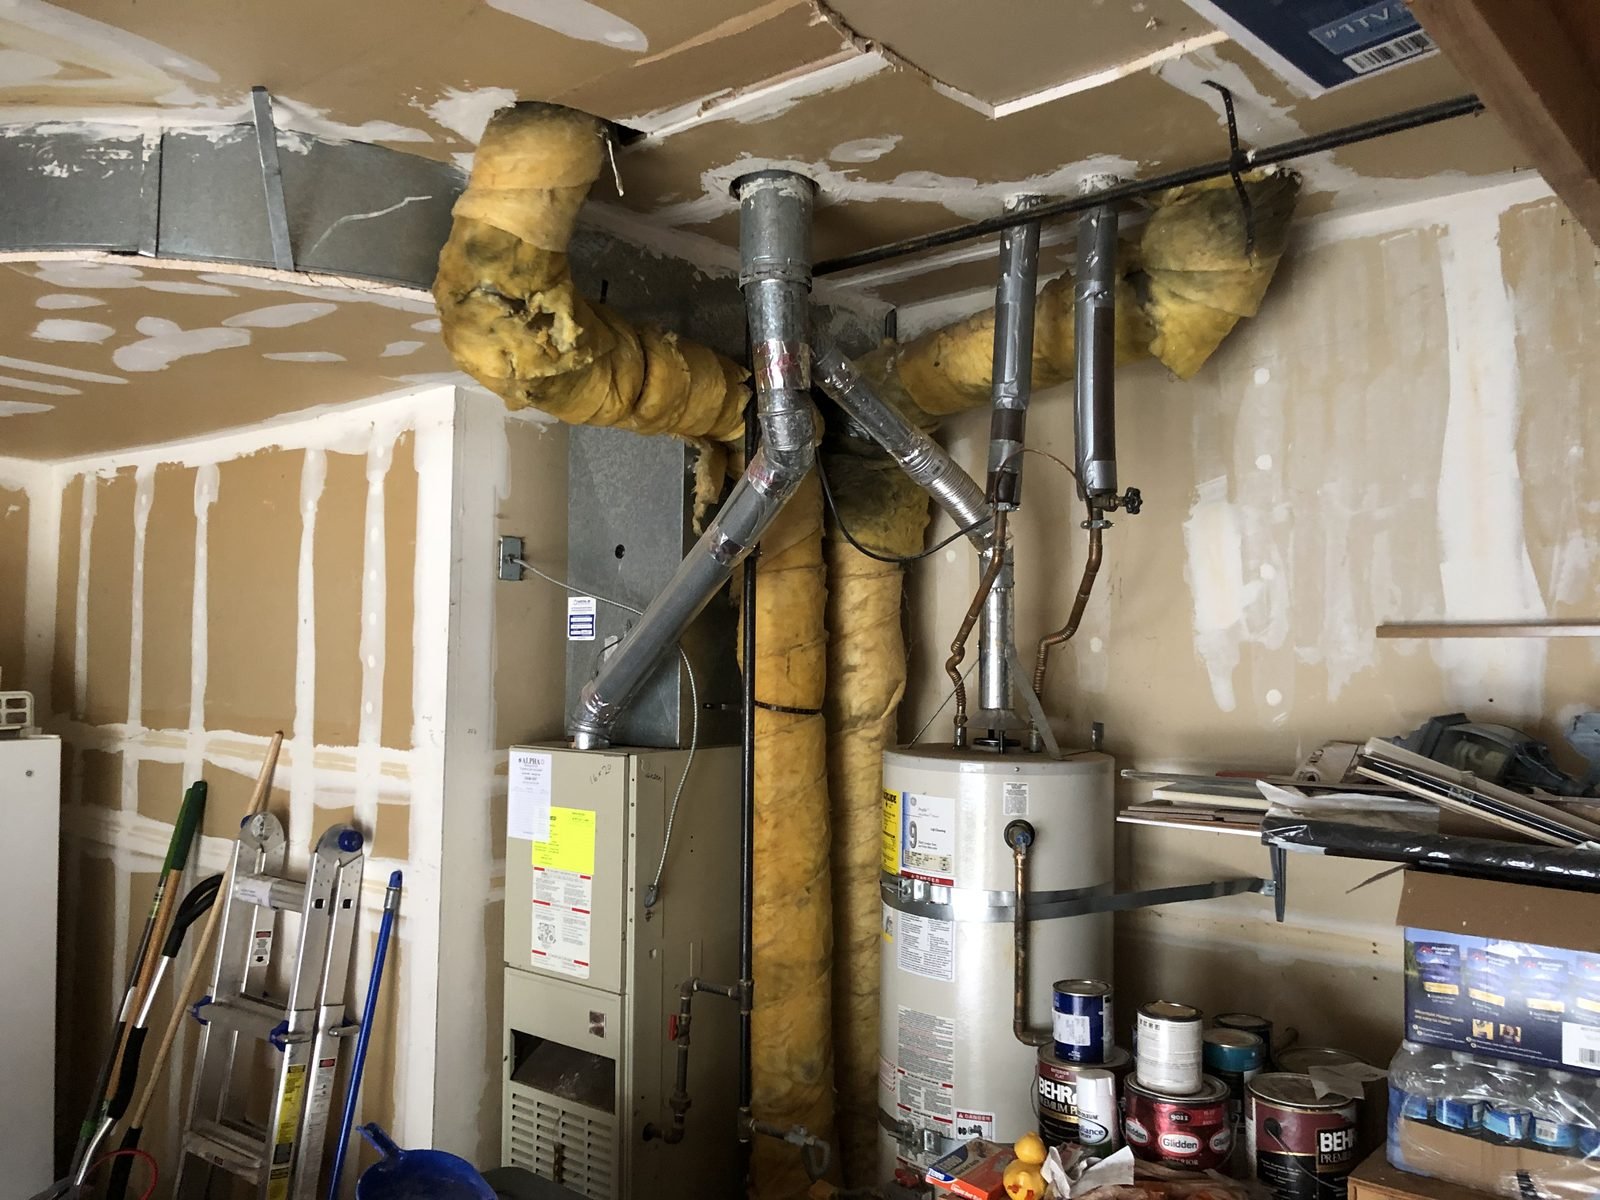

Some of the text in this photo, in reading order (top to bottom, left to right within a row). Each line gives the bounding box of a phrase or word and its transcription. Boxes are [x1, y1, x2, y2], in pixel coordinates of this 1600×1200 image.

[909, 820, 918, 849] 9
[1039, 1076, 1073, 1105] BEHR
[1163, 1138, 1198, 1149] Glidden
[1320, 1128, 1356, 1153] BEH
